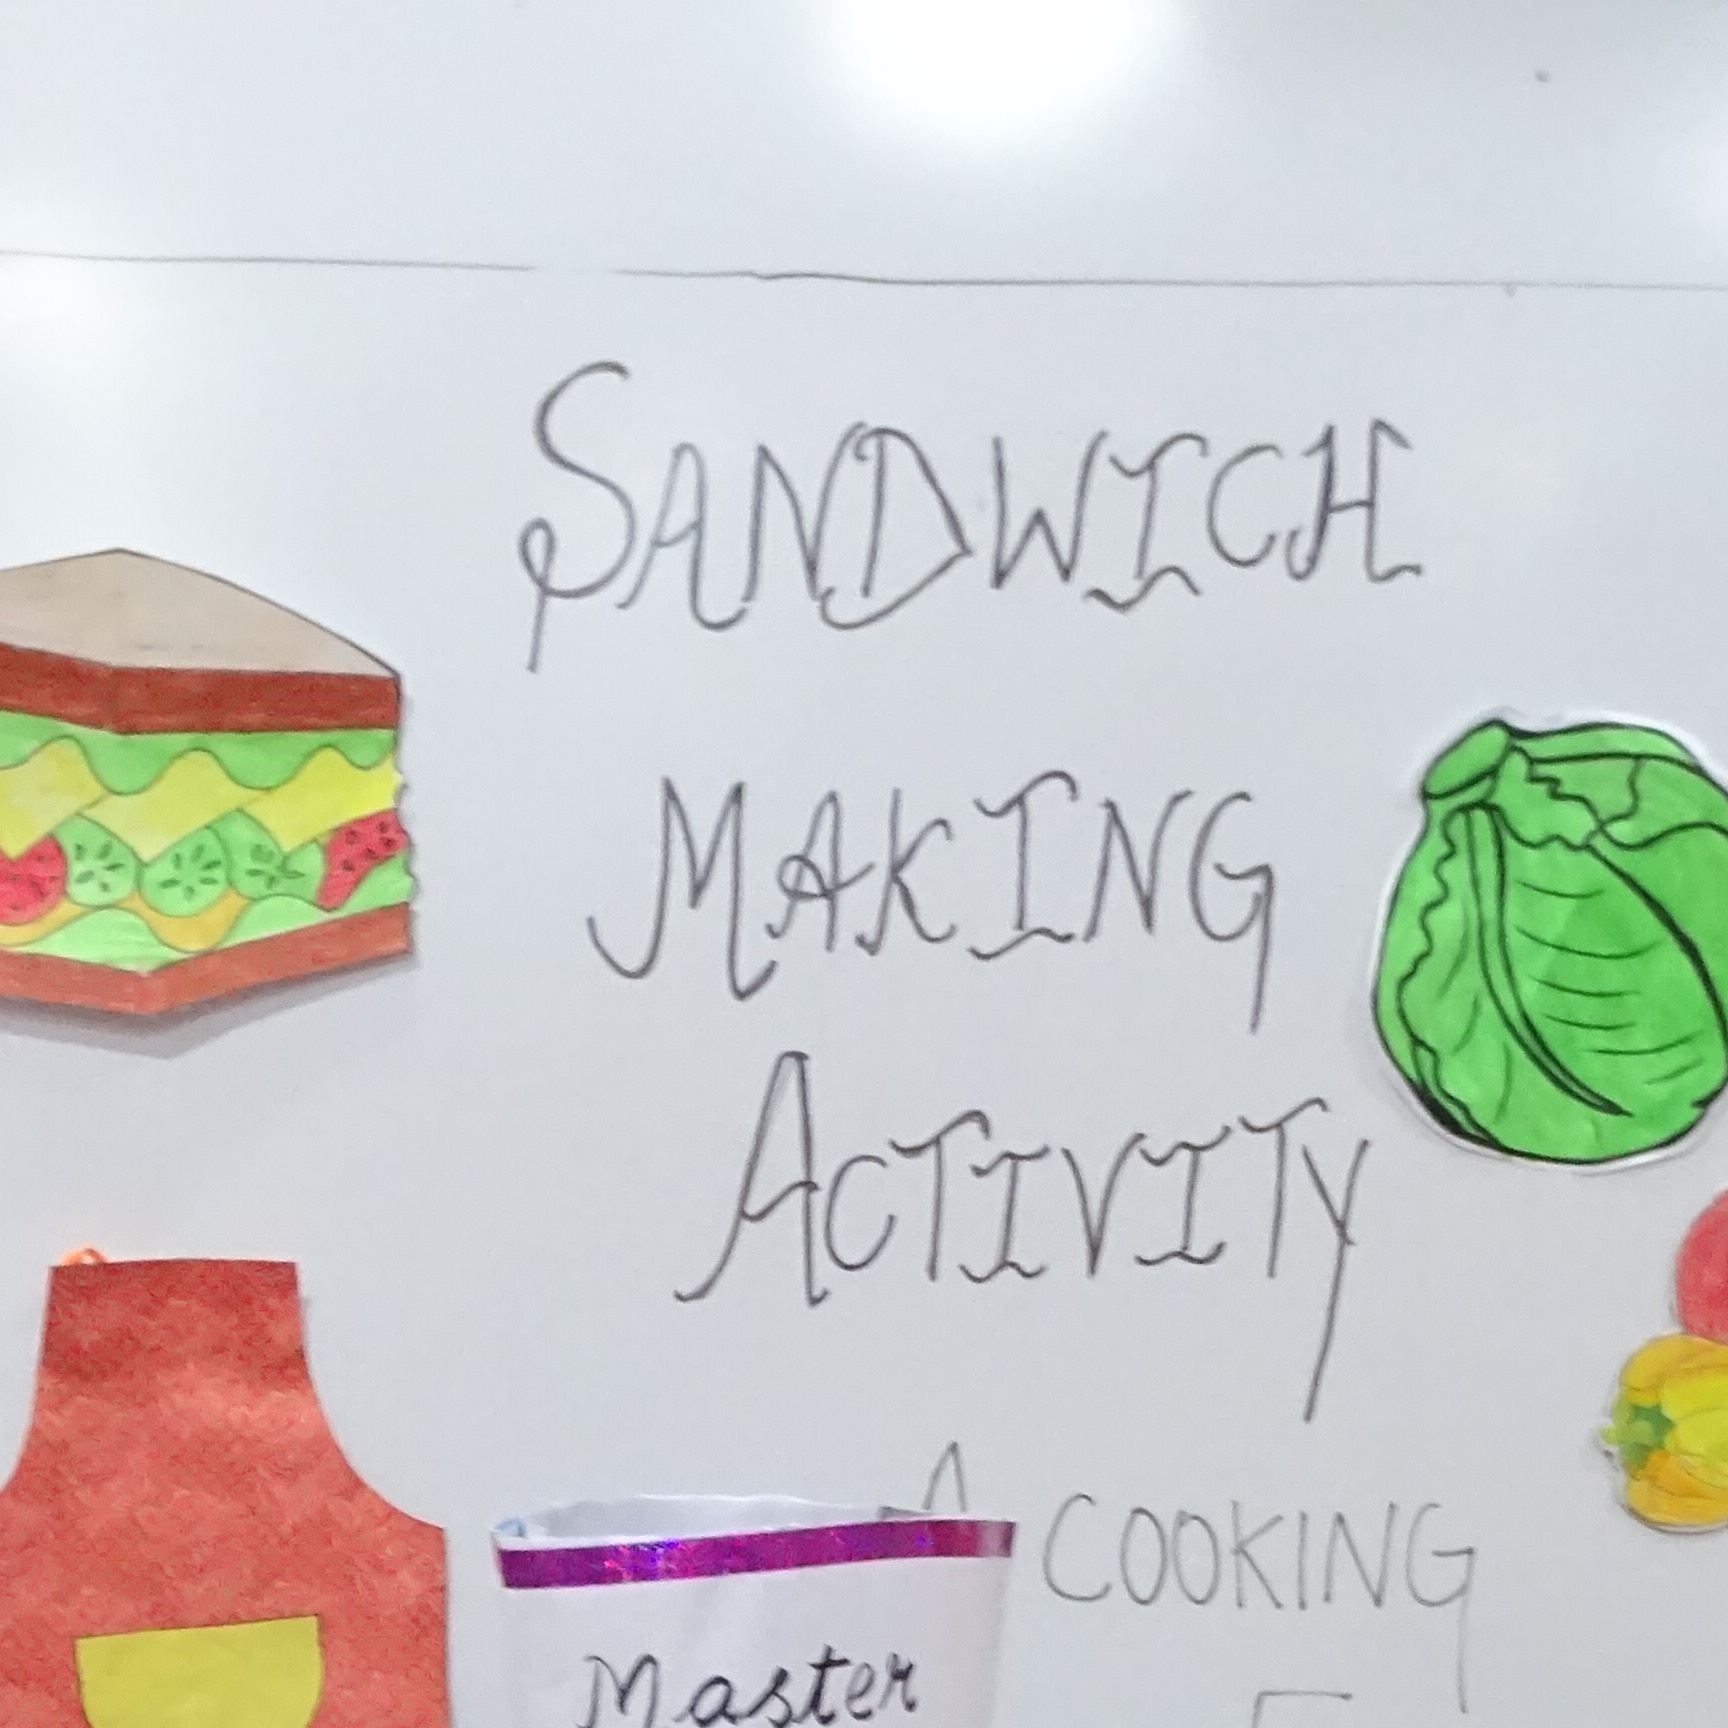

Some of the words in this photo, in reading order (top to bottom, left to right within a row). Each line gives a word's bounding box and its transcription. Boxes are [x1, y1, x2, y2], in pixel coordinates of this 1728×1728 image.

[517, 360, 1424, 674] SANDWICH
[586, 769, 1277, 1032] MAKING
[673, 1050, 1372, 1424] ACTIVITY
[1042, 1493, 1477, 1712] COOKING
